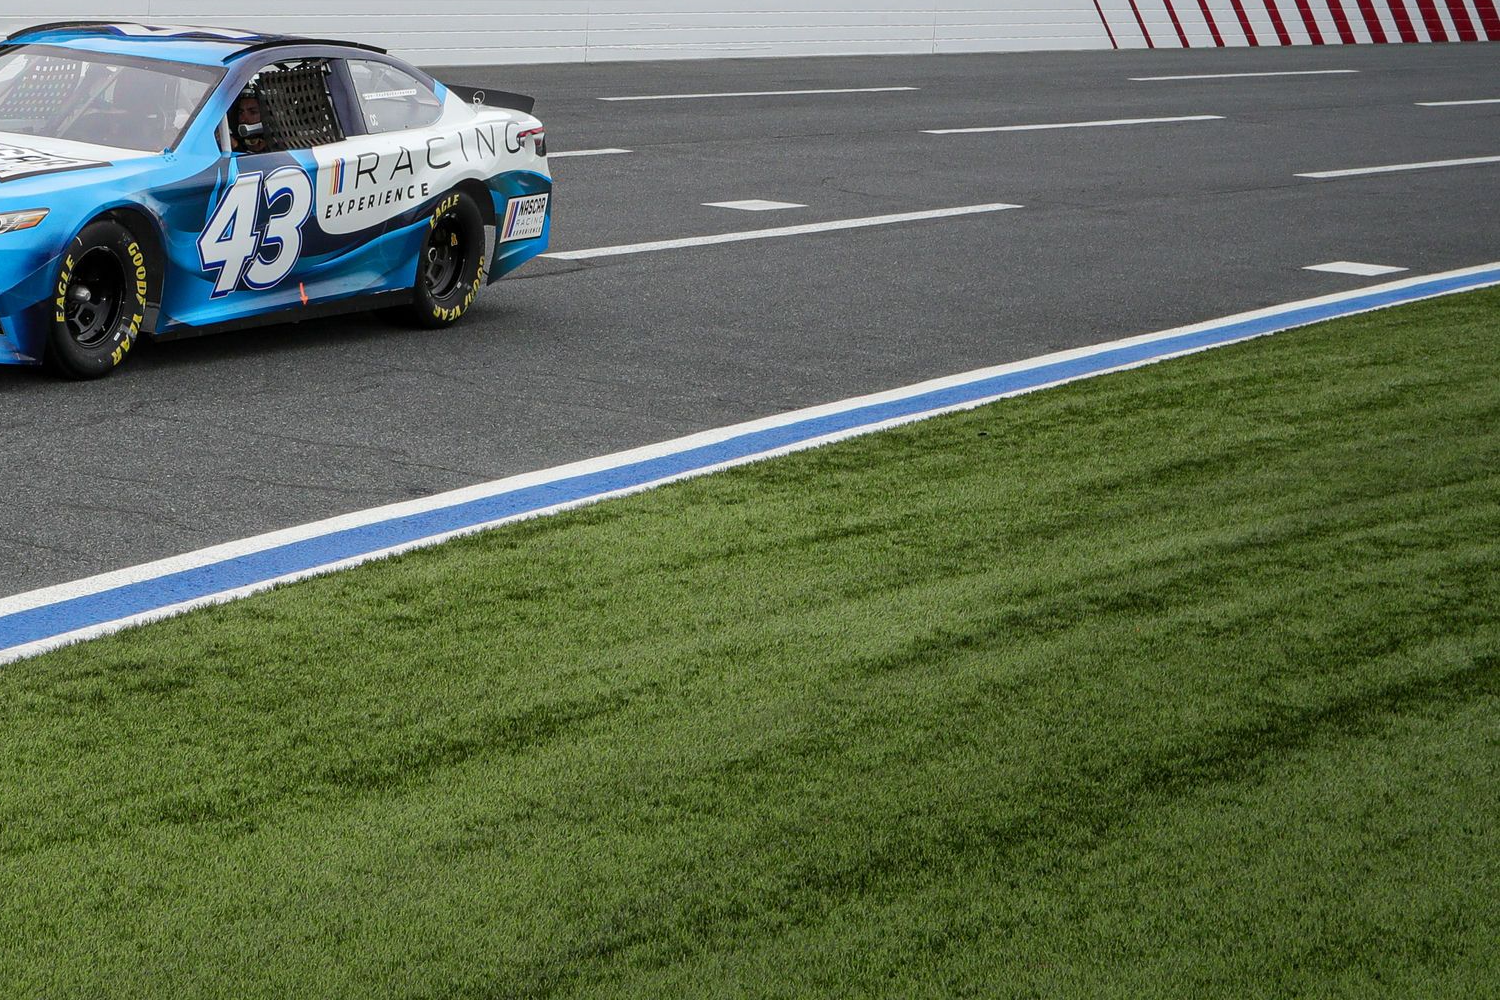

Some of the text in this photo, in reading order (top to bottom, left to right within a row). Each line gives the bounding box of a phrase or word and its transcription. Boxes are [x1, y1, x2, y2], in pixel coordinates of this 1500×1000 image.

[354, 121, 521, 189] RACING
[325, 182, 429, 219] EXPERIENCE
[429, 193, 460, 230] EAGLE
[518, 197, 546, 216] NASCAR
[195, 165, 315, 300] 43
[515, 215, 544, 227] RACING
[56, 254, 75, 322] EAGLE
